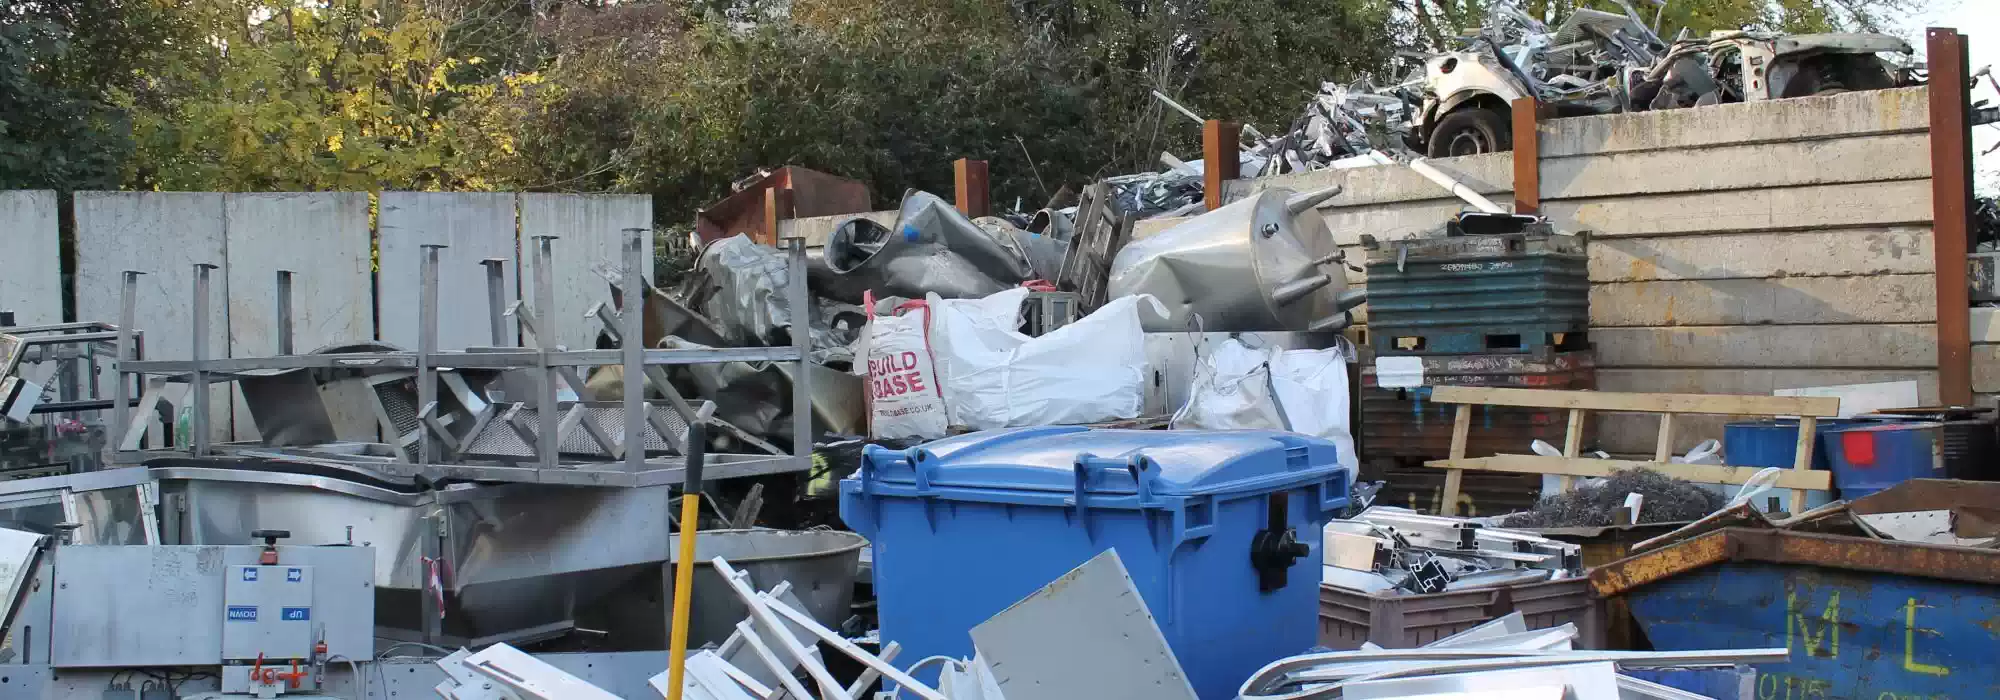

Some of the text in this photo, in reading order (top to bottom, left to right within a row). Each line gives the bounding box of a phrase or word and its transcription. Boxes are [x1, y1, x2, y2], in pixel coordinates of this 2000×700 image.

[229, 610, 256, 619] DOWN
[289, 610, 303, 619] UP
[1786, 590, 1840, 660] M
